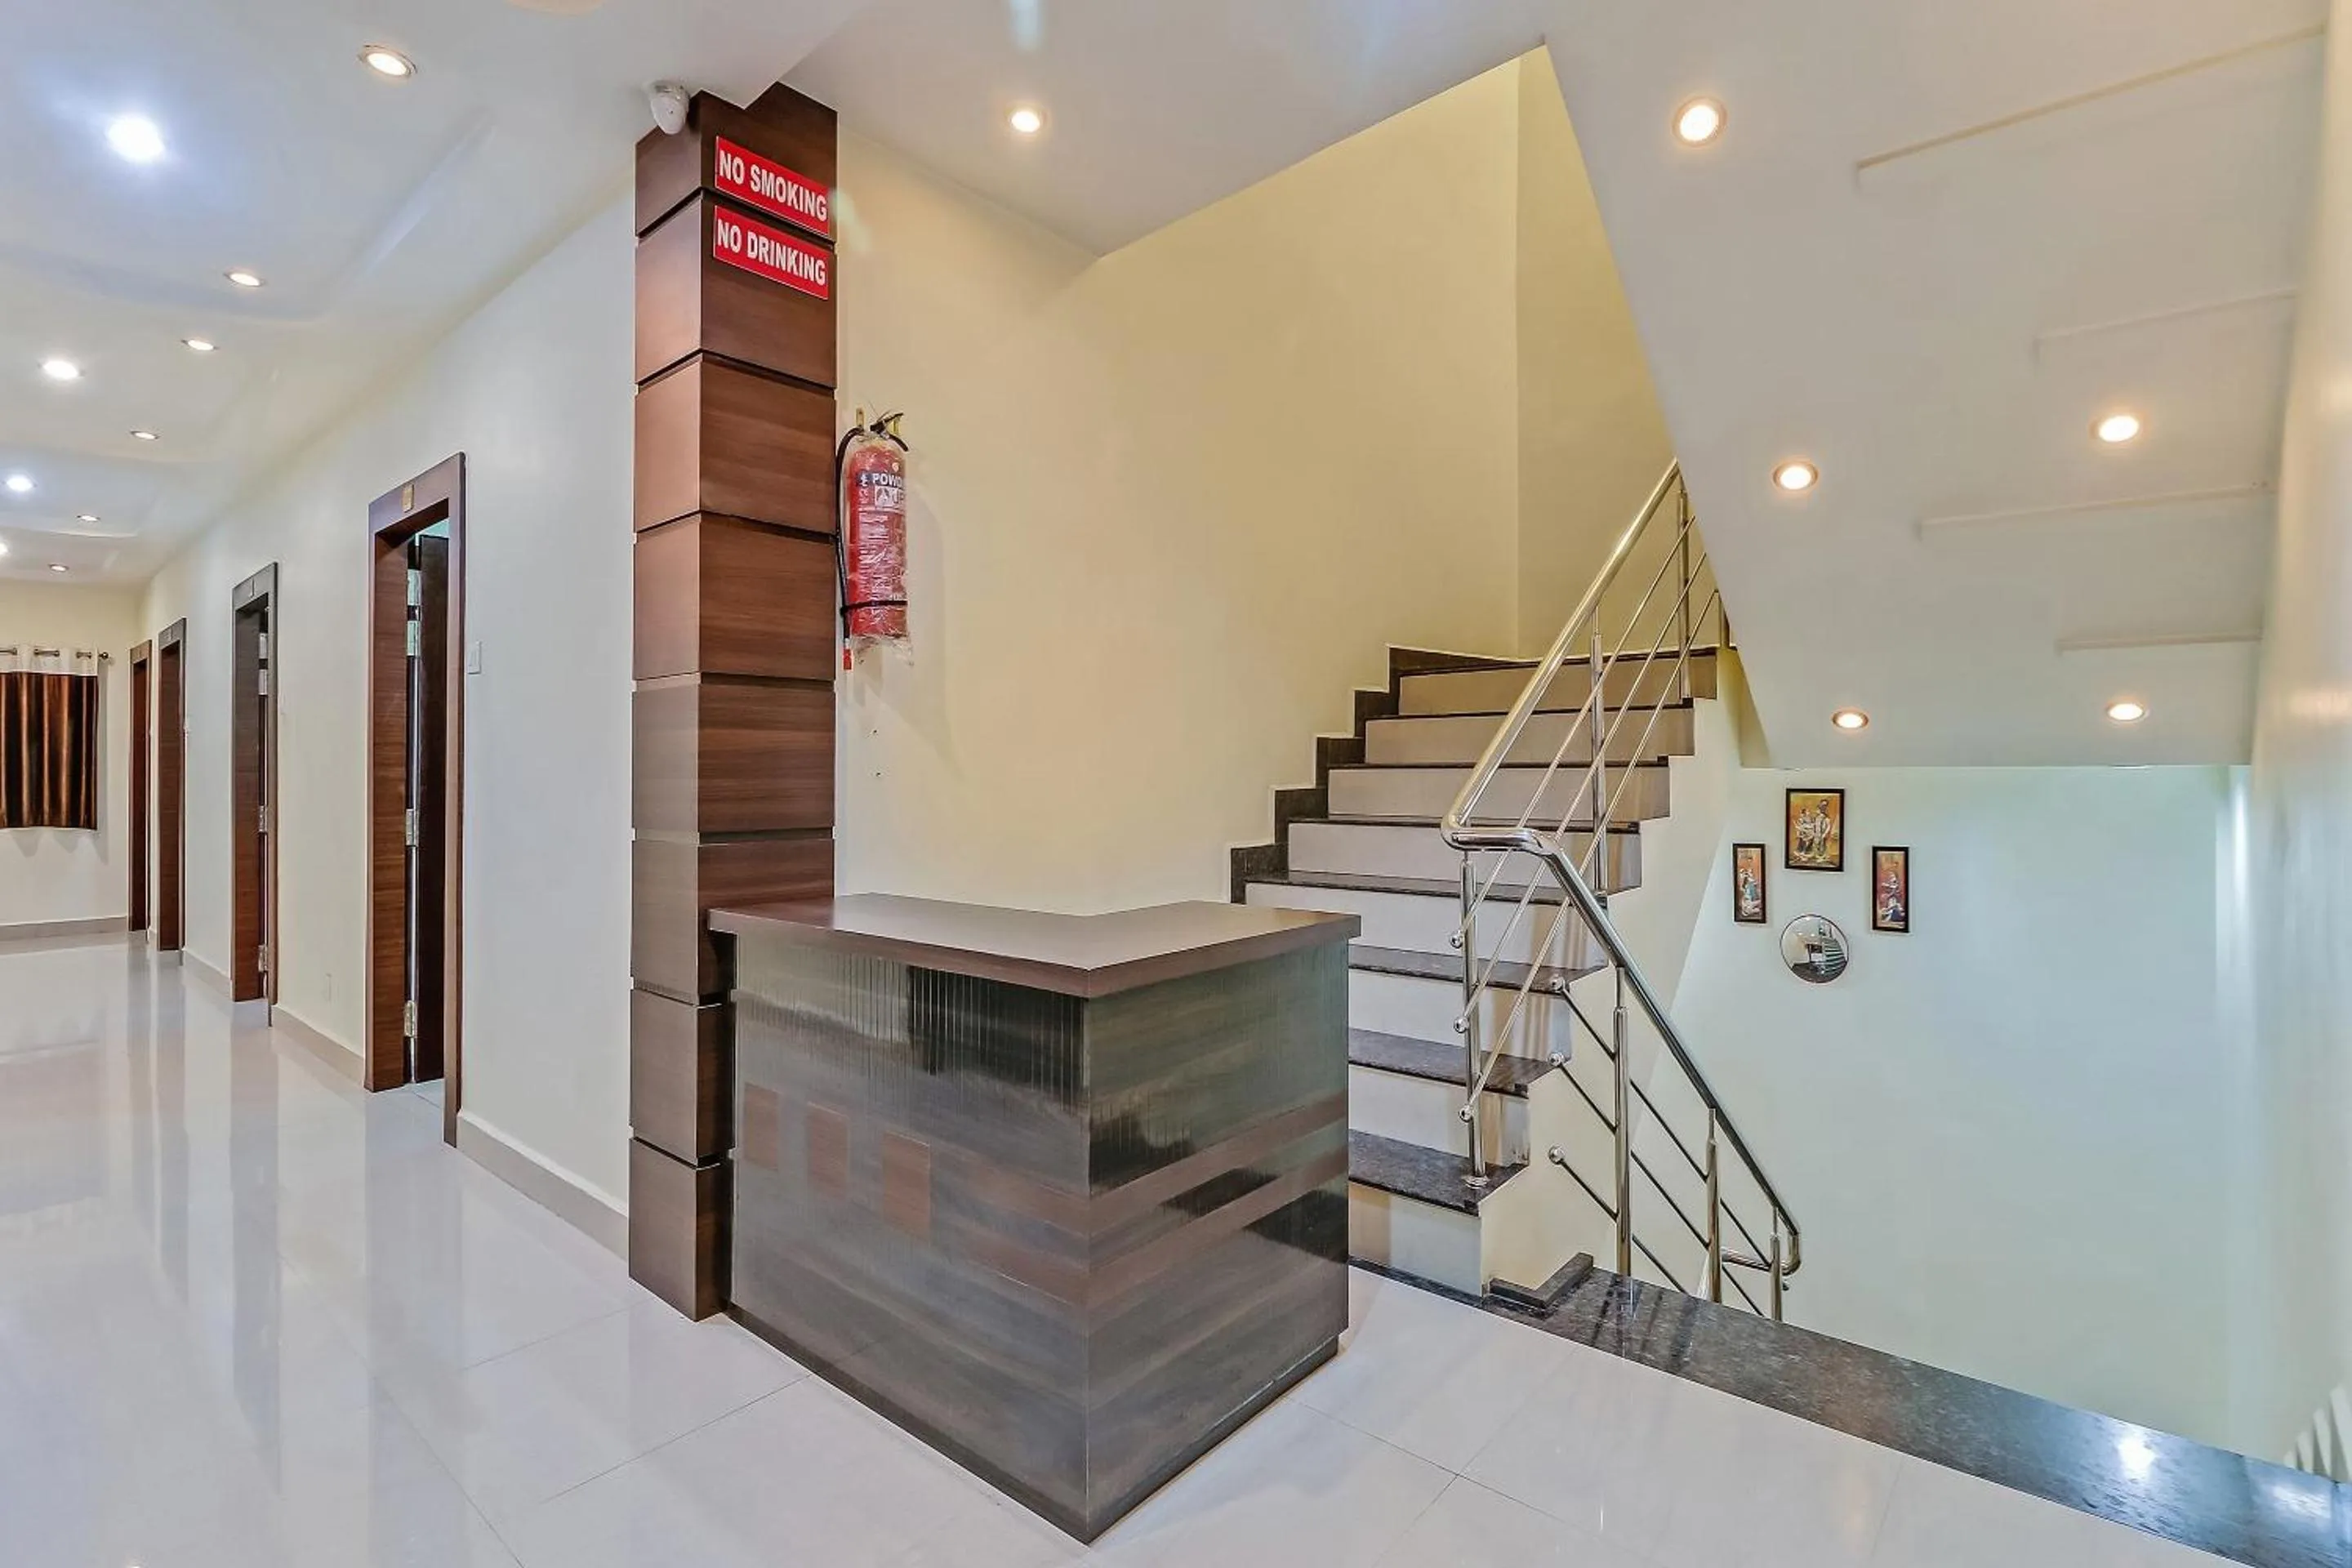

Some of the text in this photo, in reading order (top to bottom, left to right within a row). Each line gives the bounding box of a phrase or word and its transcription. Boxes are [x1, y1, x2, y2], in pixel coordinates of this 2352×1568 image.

[719, 149, 828, 221] NO SMOKING
[717, 218, 826, 286] NO DRINKING
